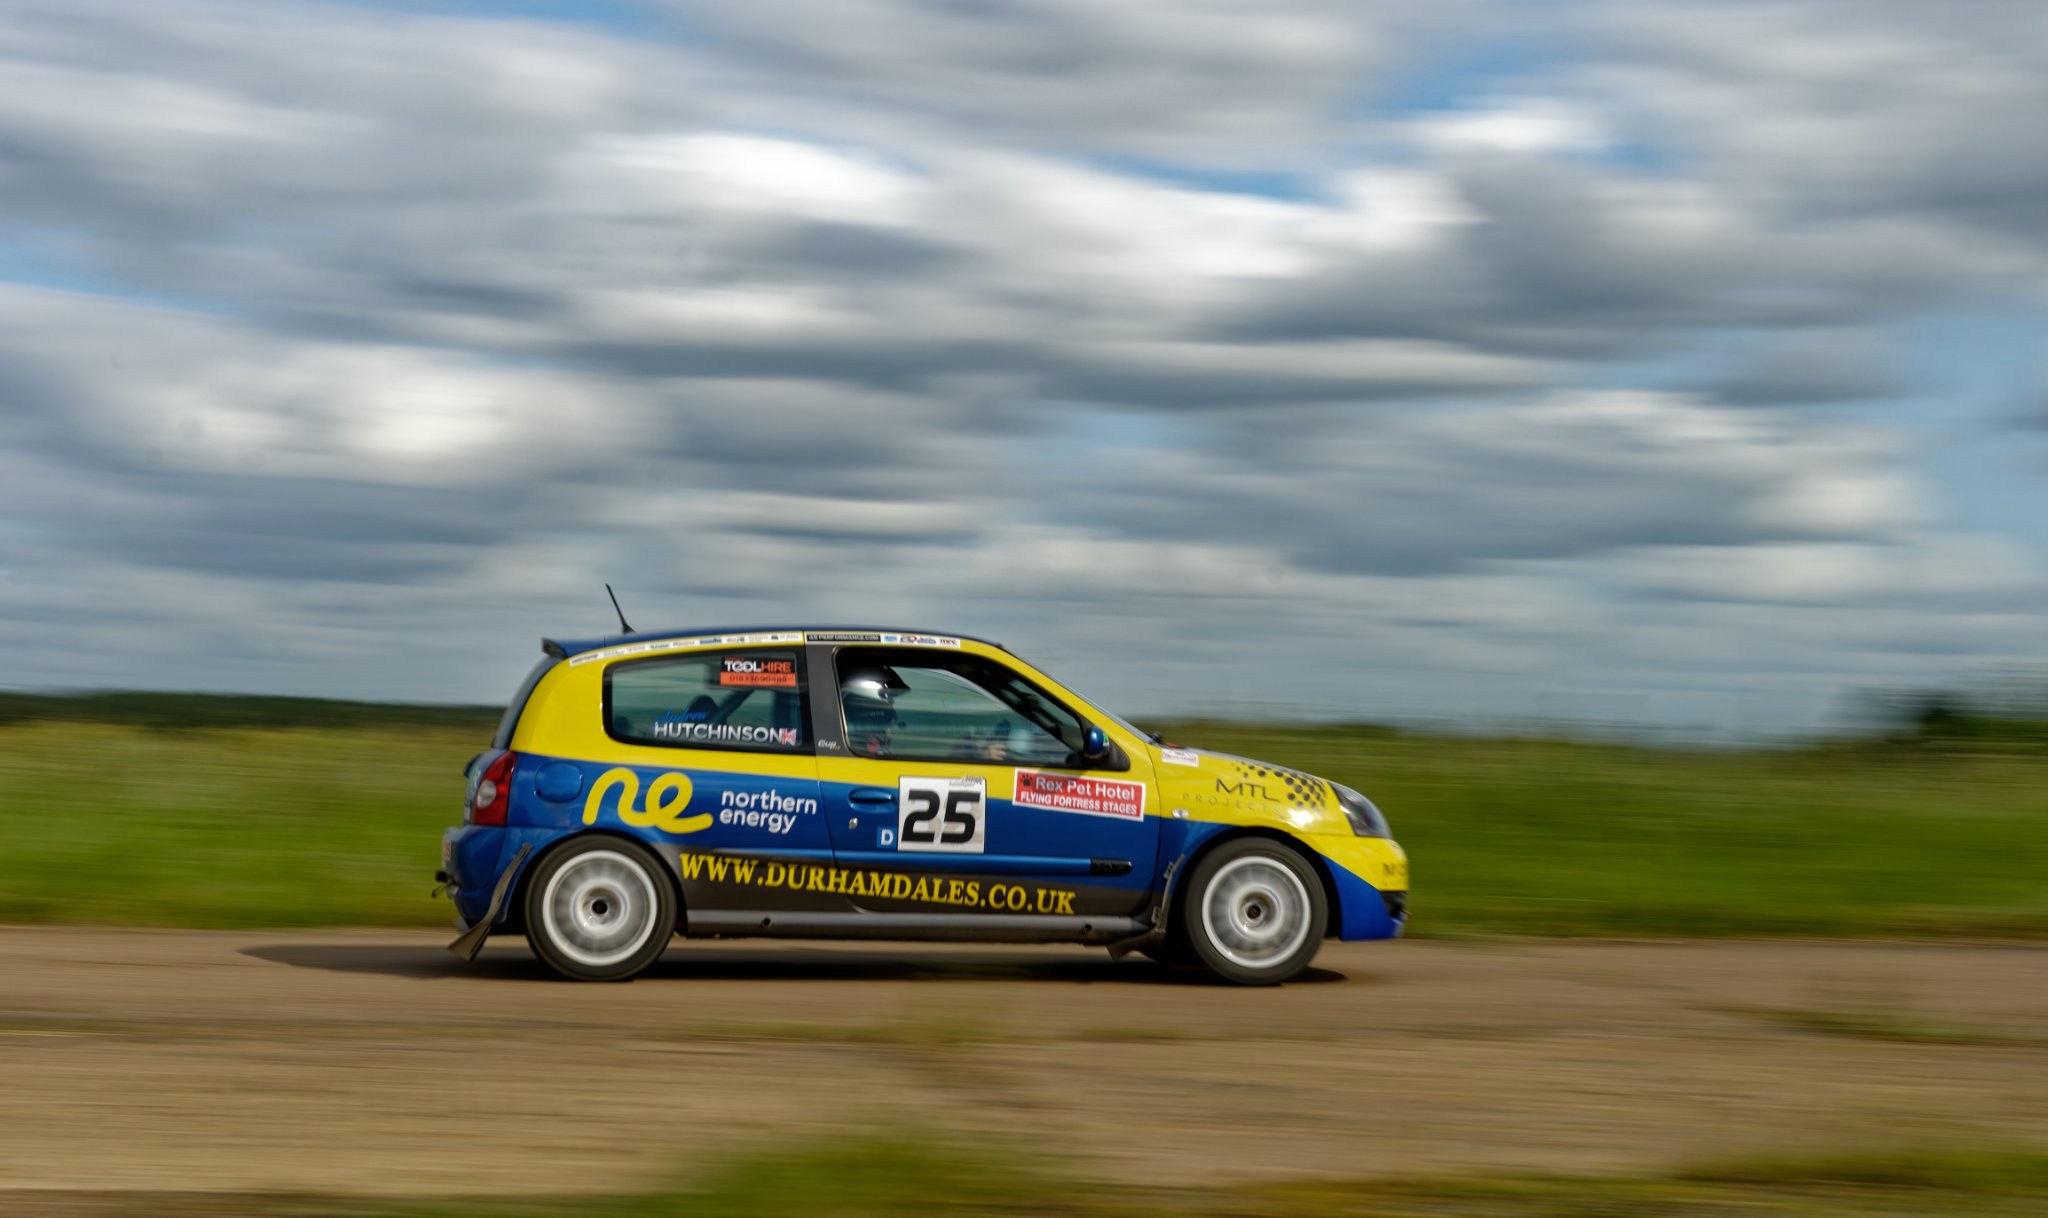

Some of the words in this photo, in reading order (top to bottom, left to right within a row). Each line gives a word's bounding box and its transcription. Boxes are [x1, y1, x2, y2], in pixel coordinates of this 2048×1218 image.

[654, 722, 783, 745] HUTCHINSON
[1035, 776, 1063, 793] Rex
[1067, 780, 1092, 796] Pet
[1095, 783, 1135, 801] Hotel
[1216, 778, 1280, 802] MTL
[721, 789, 817, 814] northern
[1020, 791, 1052, 804] FLYING
[1053, 795, 1101, 810] FORTRESS
[1102, 801, 1137, 816] STAGES
[719, 808, 797, 834] energy
[901, 790, 981, 844] 25
[880, 829, 894, 846] D
[679, 852, 1077, 915] WWW.DURHAMDALES.CO.UK
